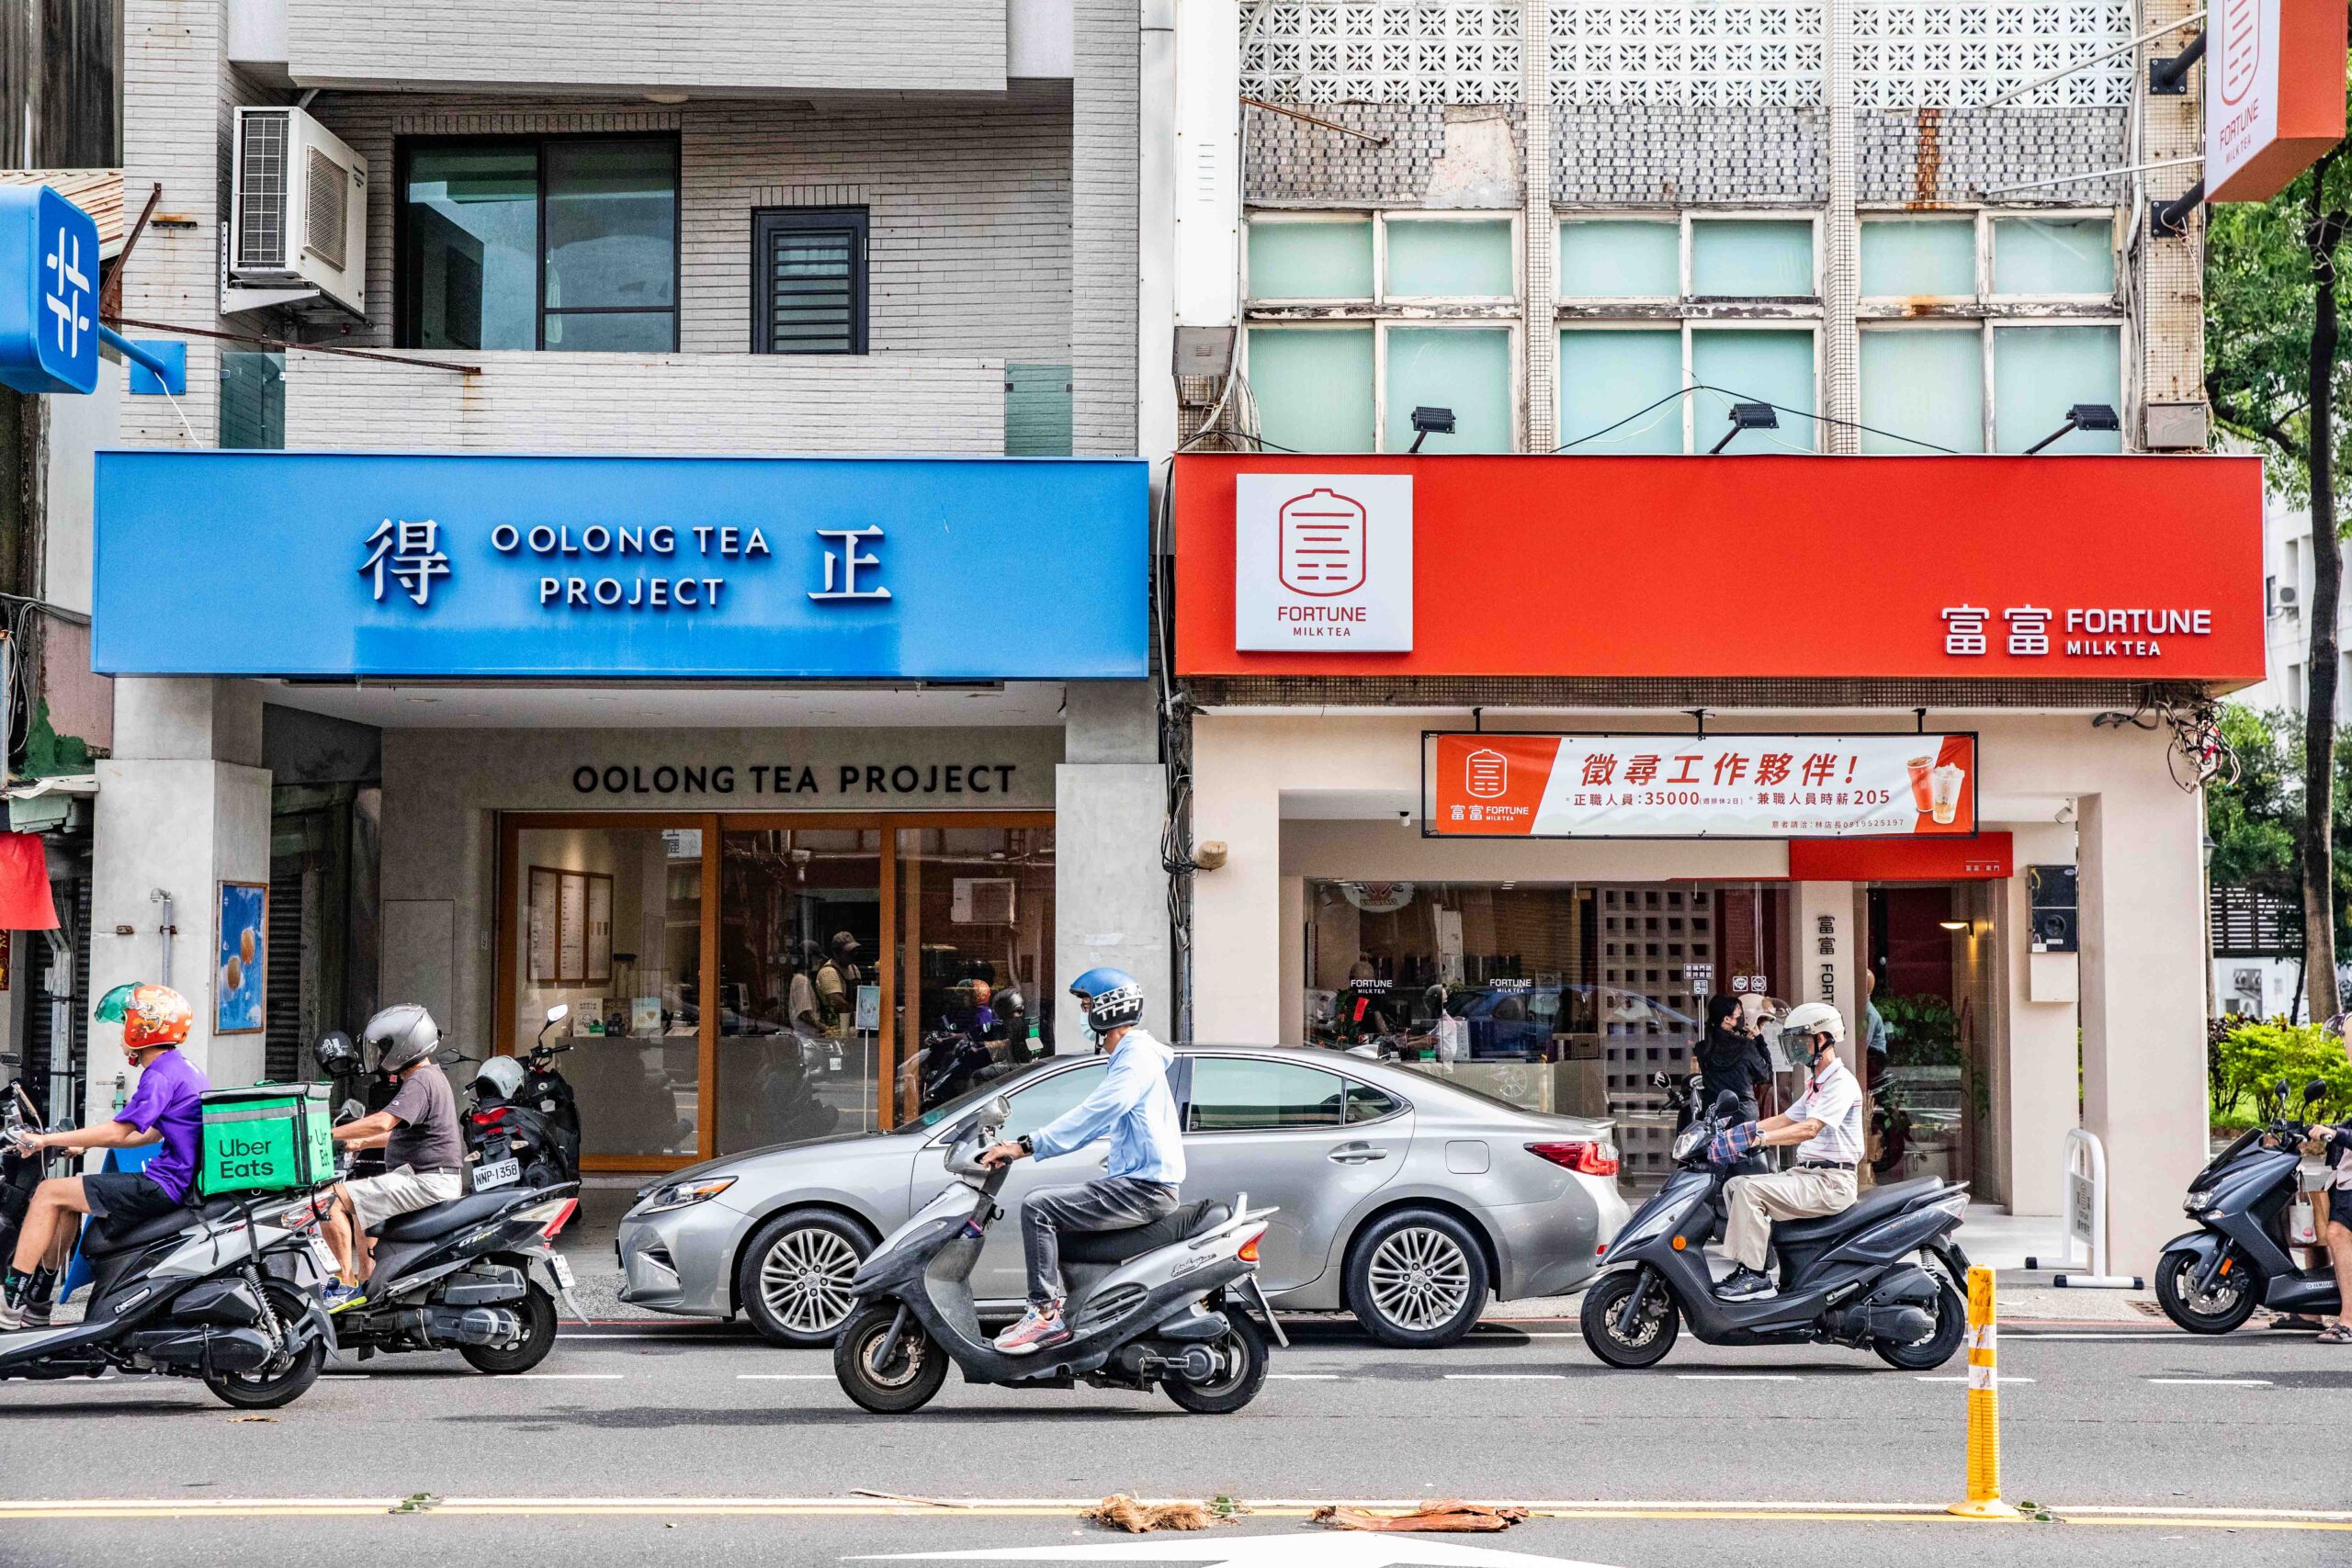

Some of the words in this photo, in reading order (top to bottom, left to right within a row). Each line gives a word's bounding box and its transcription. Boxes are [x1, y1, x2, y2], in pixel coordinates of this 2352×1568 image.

[2220, 97, 2259, 151] FORTUNE
[2225, 144, 2240, 164] MILK
[2240, 134, 2251, 152] TEA
[491, 524, 675, 554] OOLONG
[692, 525, 771, 554] TEA
[356, 517, 451, 606] 得
[807, 524, 892, 603] 正
[538, 577, 725, 606] PROJECT
[1278, 606, 1366, 622] FORTUNE
[2066, 608, 2211, 635] FORTUNE
[1293, 626, 1324, 637] MILK
[1327, 626, 1351, 637] TEA
[1940, 604, 2053, 656] 富富
[2065, 640, 2117, 656] MILK
[2121, 640, 2161, 656] TEA
[572, 765, 736, 795] OOLONG
[749, 765, 820, 795] TEA
[839, 764, 1017, 795] PROJECT
[1450, 804, 1485, 821] 富富
[1486, 806, 1529, 816] FORTUNE
[1818, 915, 1836, 955] 富富
[1351, 979, 1393, 987] FORTUNE
[1489, 978, 1532, 987] FORTUNE
[1822, 964, 1835, 1006] FORT
[220, 1139, 272, 1157] Uber
[220, 1160, 274, 1179] Eats
[475, 1164, 517, 1186] NNP-1358
